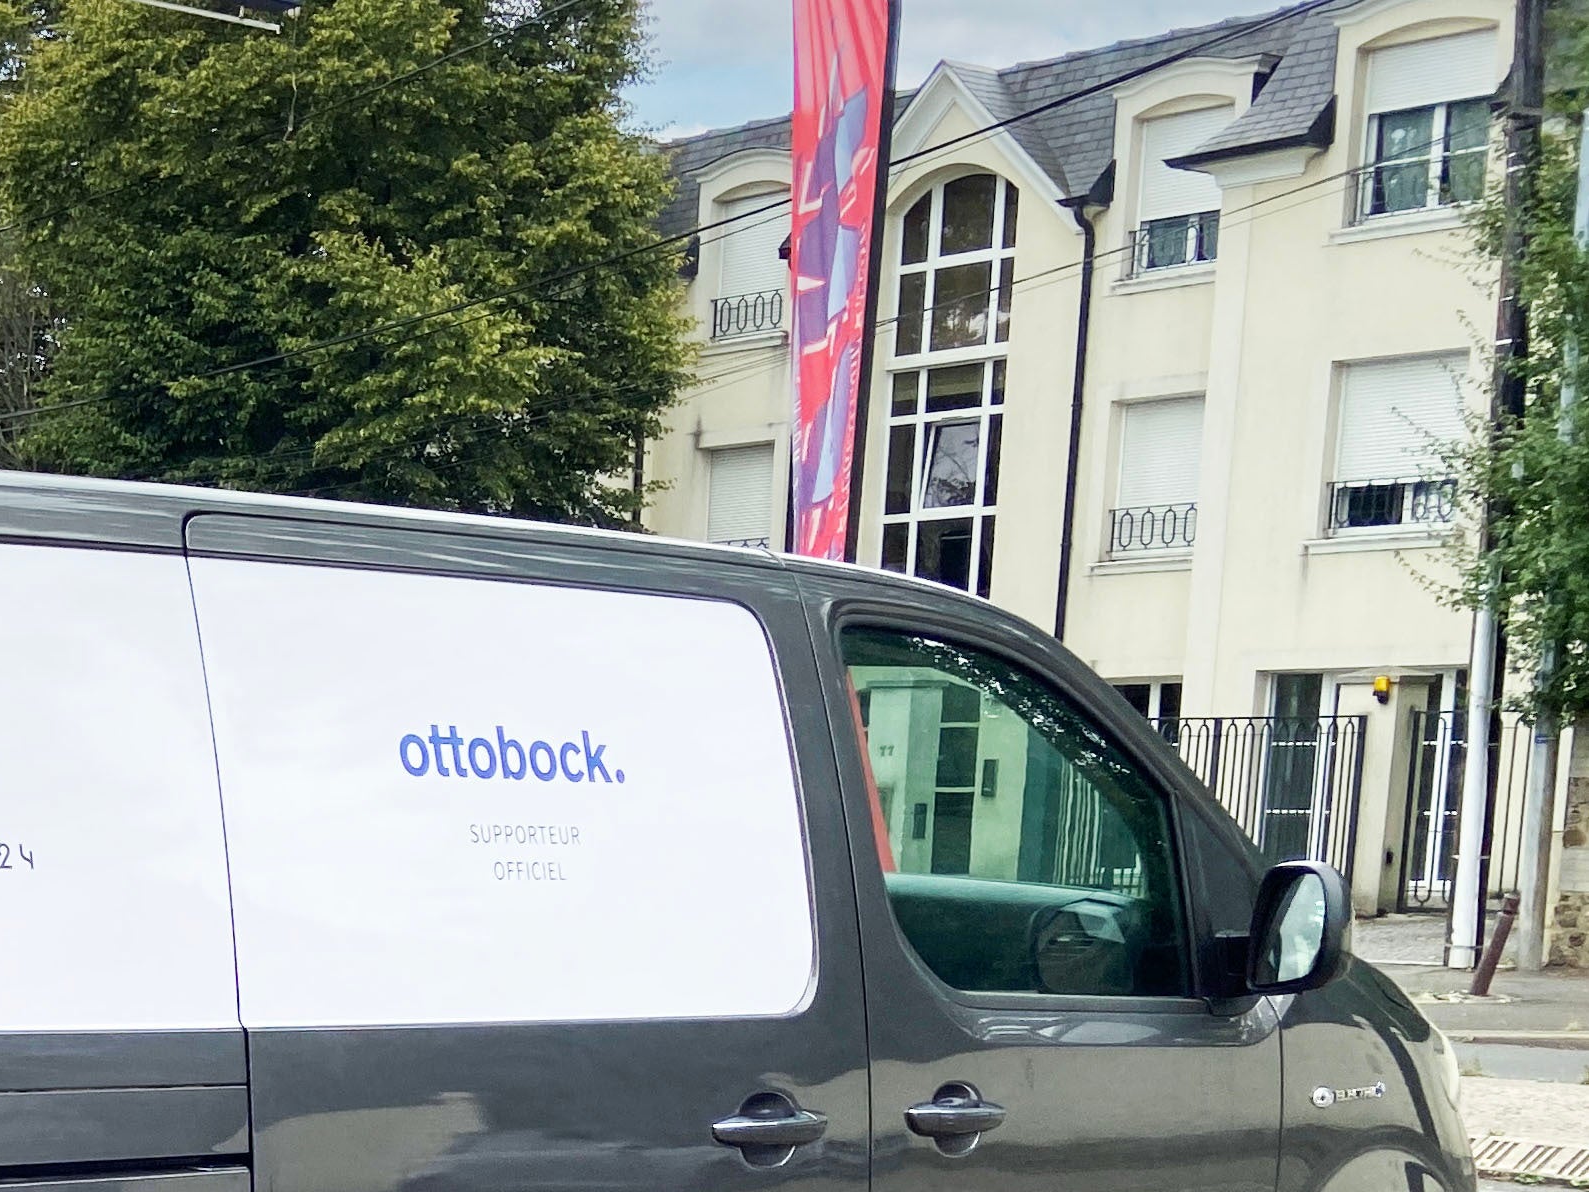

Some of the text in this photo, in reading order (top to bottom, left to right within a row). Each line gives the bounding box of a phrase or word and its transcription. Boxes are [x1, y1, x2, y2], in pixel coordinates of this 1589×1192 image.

[399, 724, 626, 784] ottobock.
[470, 823, 582, 846] SUPPORTEUR
[493, 860, 568, 882] OFFICIEL
